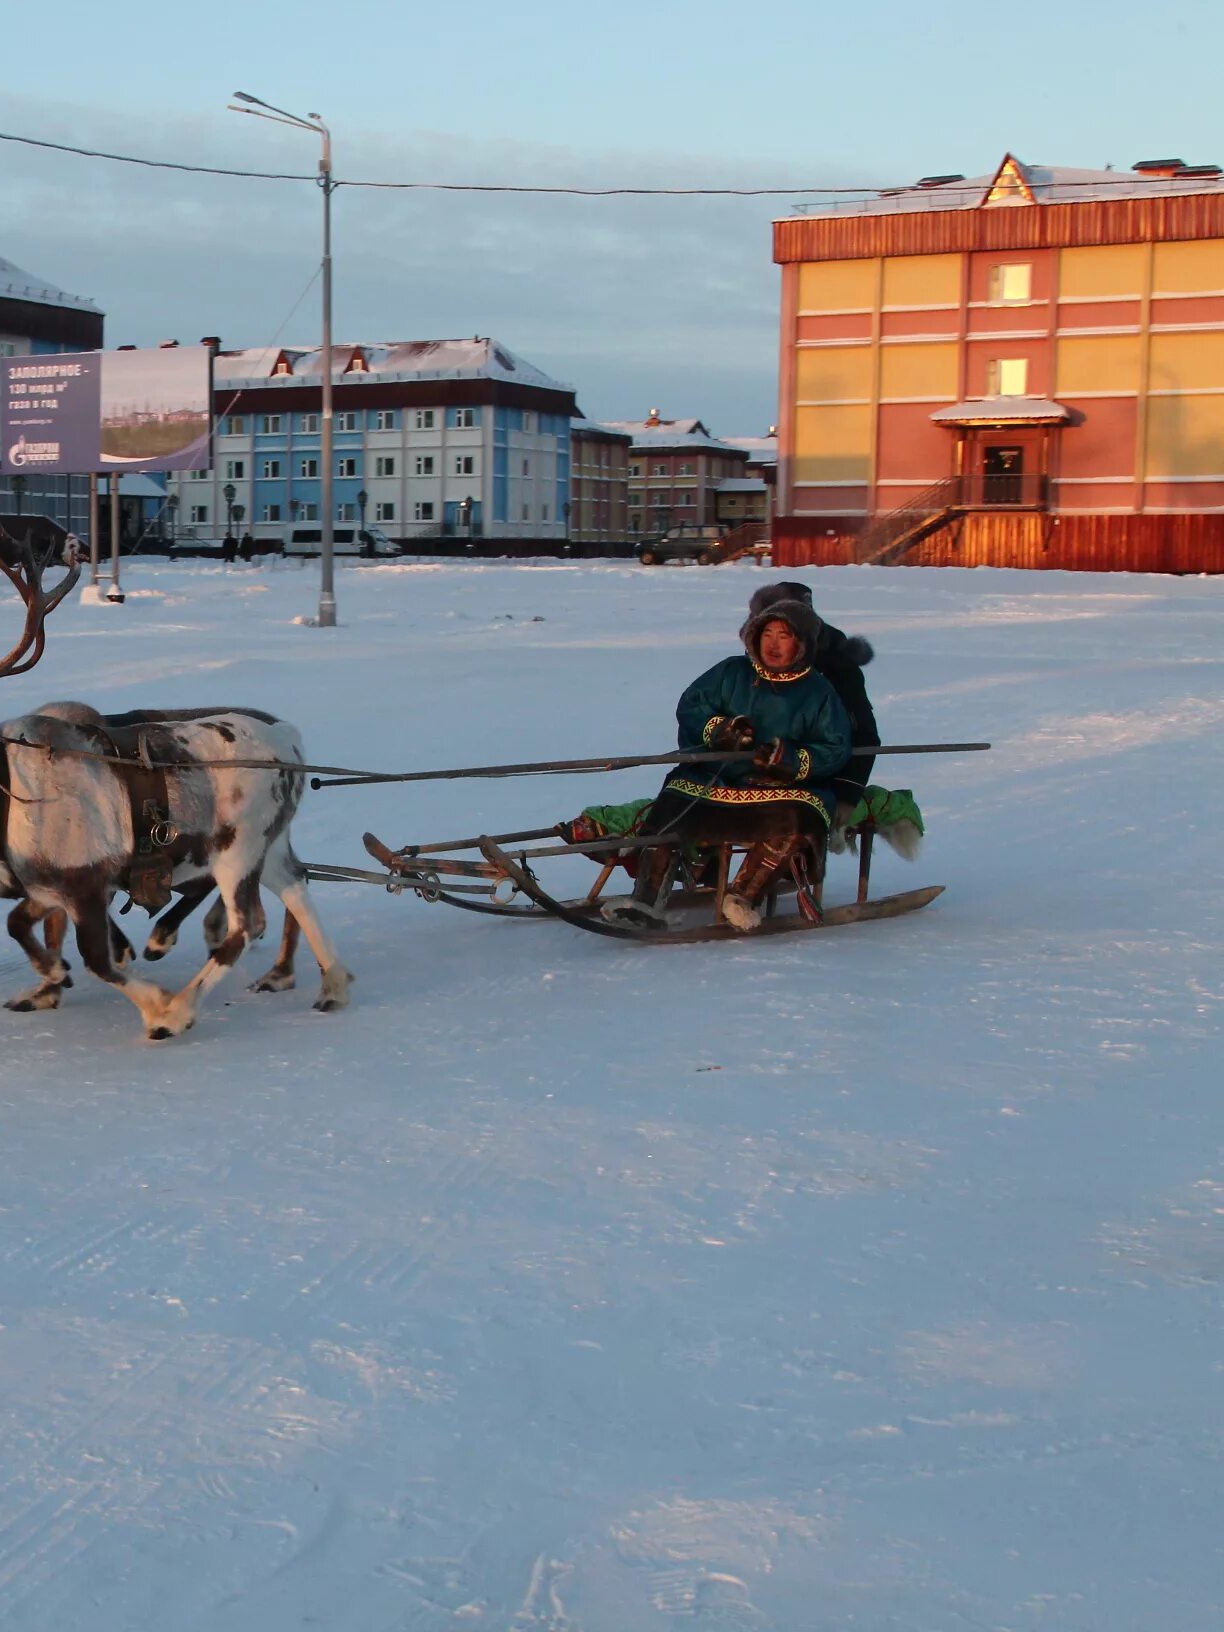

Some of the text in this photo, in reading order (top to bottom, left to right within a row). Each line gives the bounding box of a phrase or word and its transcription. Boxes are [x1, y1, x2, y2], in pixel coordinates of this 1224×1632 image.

[8, 364, 81, 379] ЗАПОЛЯРНОЕ
[9, 384, 27, 394] 130
[28, 384, 54, 395] млрд
[9, 399, 58, 409] газа в год
[24, 442, 60, 454] ГАЗПРОМ
